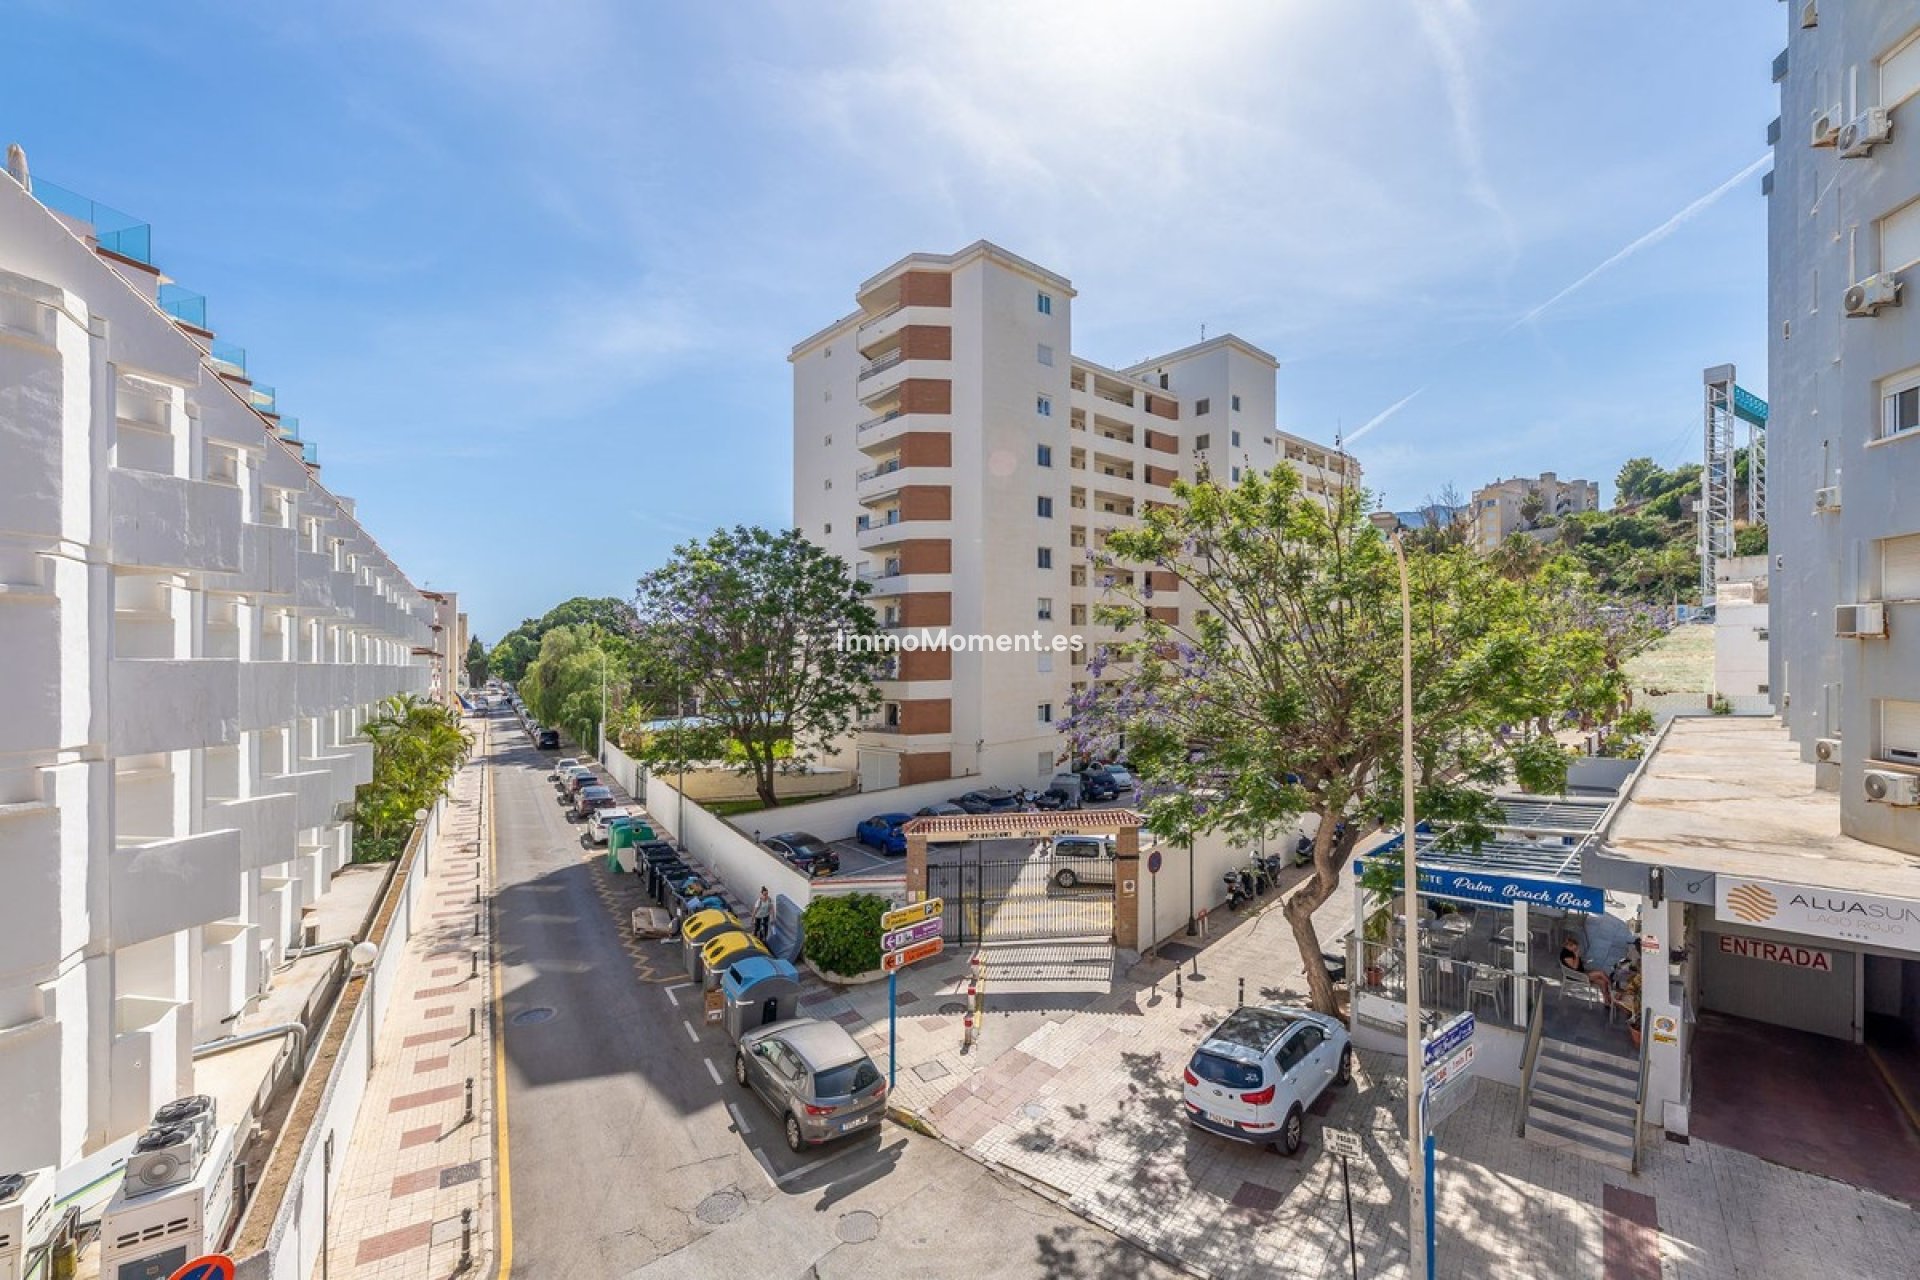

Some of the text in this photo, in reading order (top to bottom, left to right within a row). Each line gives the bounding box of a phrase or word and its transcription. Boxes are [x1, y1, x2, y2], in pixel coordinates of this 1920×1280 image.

[1453, 877, 1494, 893] Palm
[1502, 884, 1551, 900] Beach
[1556, 892, 1592, 908] Bar
[1789, 894, 1920, 923] ALUASUN
[1807, 914, 1905, 935] LAGO ROJO
[1720, 935, 1829, 971] ENTRADA
